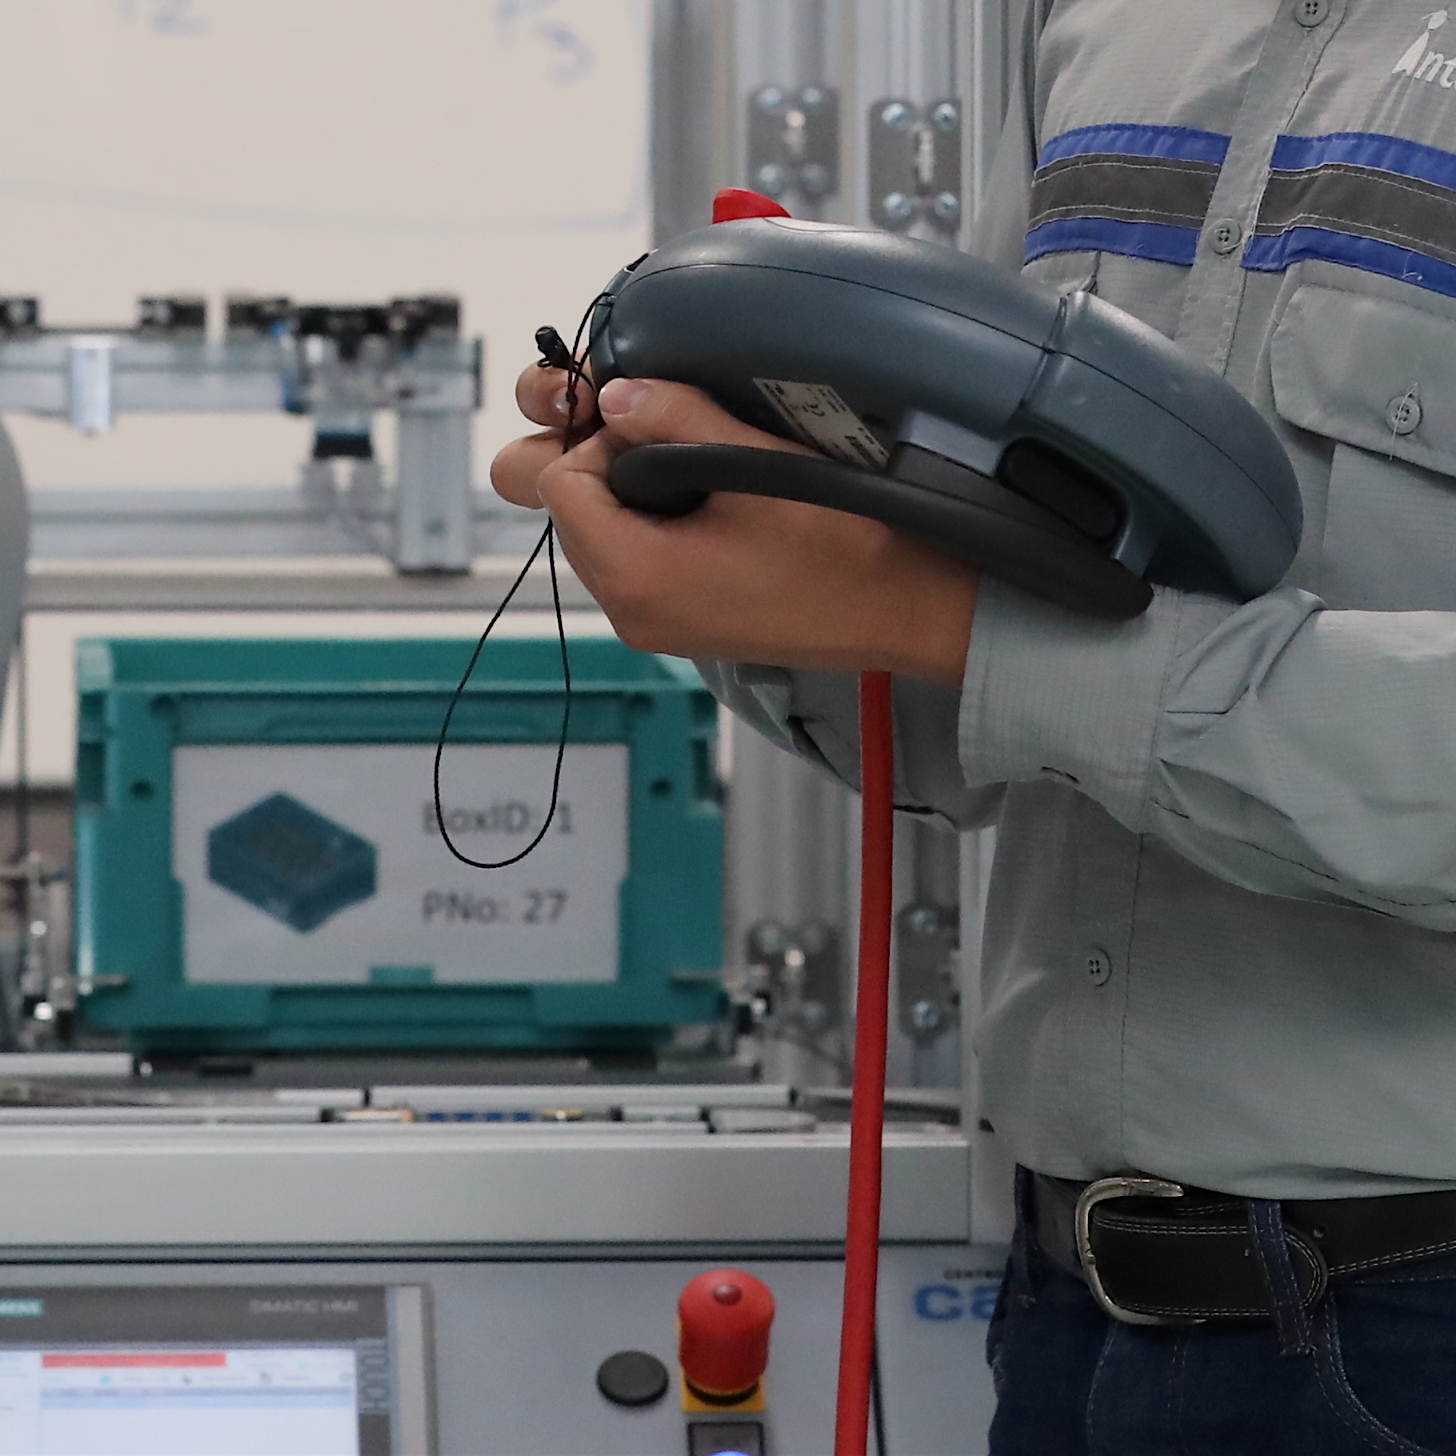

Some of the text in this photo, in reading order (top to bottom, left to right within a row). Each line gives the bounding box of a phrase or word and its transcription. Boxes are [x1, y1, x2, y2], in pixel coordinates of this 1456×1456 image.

[556, 800, 576, 835] 1
[421, 888, 570, 926] PNo: 27
